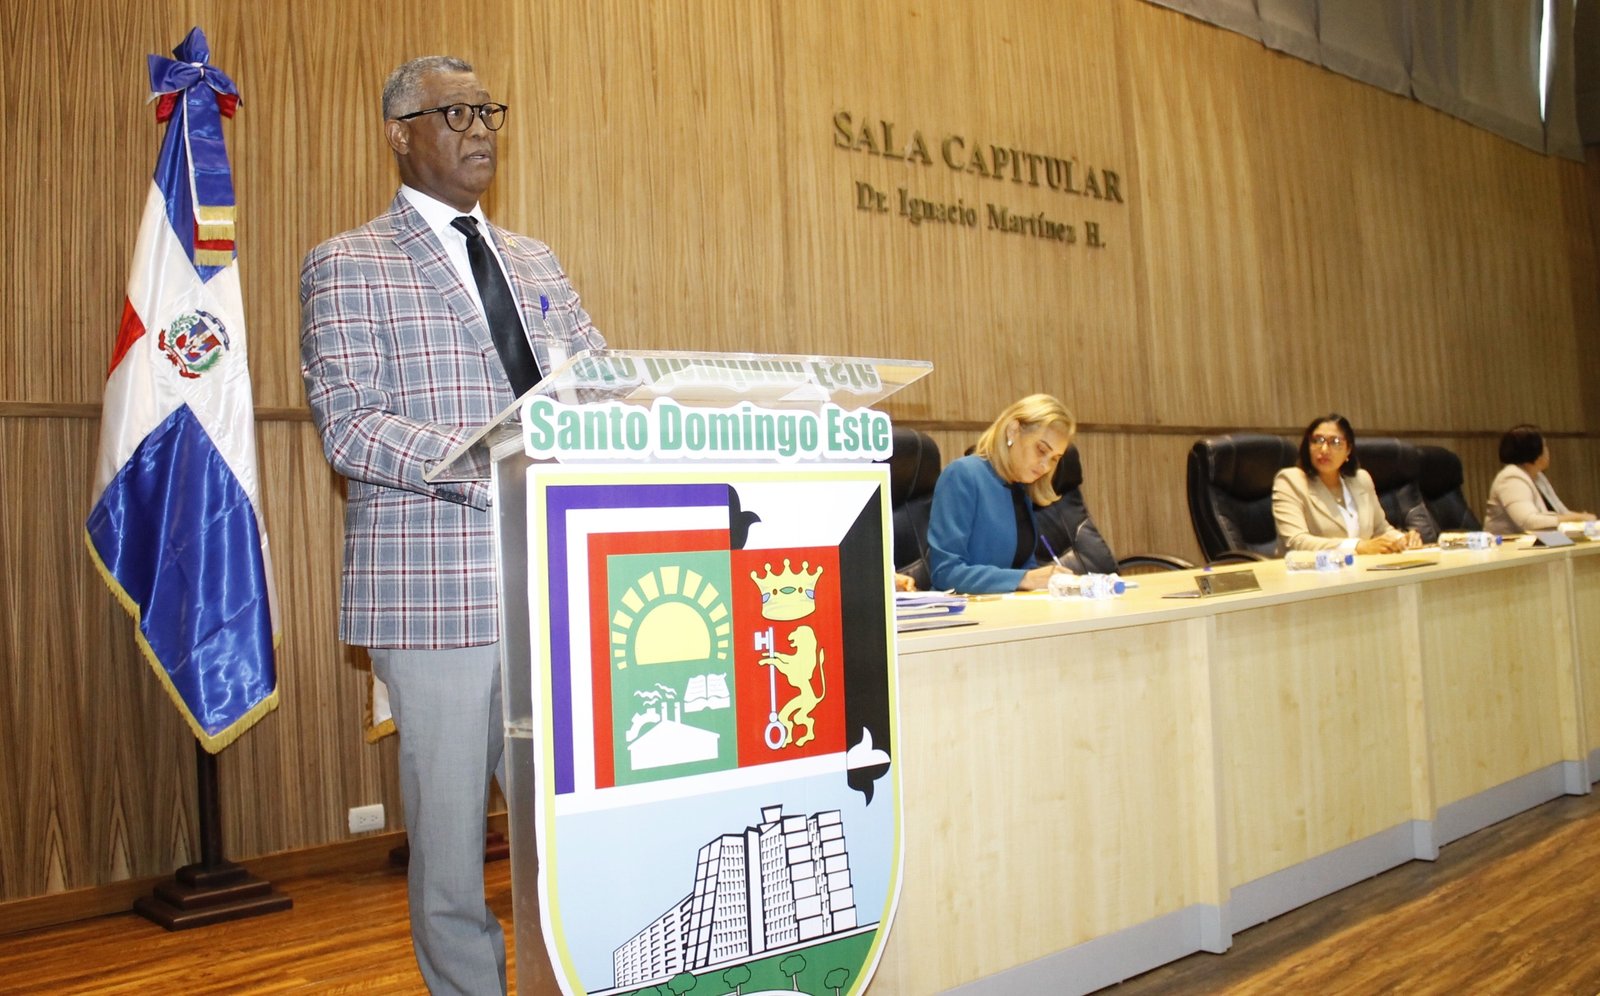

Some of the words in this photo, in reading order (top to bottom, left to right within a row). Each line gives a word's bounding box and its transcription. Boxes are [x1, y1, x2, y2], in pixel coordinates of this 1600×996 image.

[833, 111, 933, 165] SALA
[941, 135, 1124, 203] CAPITULAR
[855, 181, 889, 213] Dr.
[898, 188, 977, 226] Ignacio
[986, 204, 1076, 244] Martínez
[1084, 220, 1106, 248] H.
[530, 401, 648, 451] Santo
[659, 404, 819, 456] Domingo
[828, 409, 890, 452] Este
